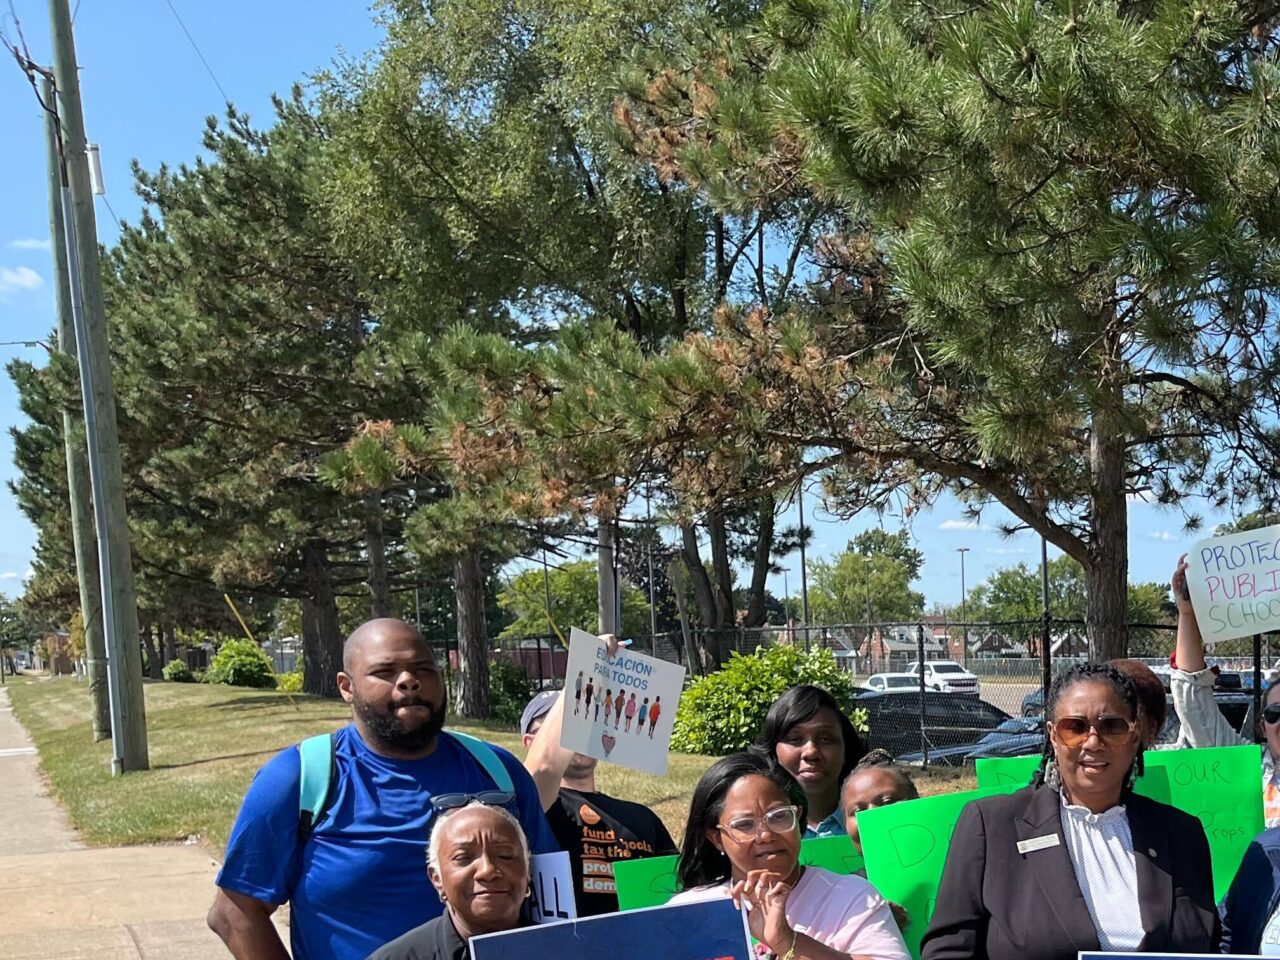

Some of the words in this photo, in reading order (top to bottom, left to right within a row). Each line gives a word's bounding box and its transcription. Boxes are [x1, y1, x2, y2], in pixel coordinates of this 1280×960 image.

[612, 670, 648, 691] TODOS
[1174, 761, 1231, 785] OUR
[582, 826, 615, 840] fund
[583, 843, 605, 856] tax
[607, 845, 632, 858] the
[583, 862, 613, 875] prot
